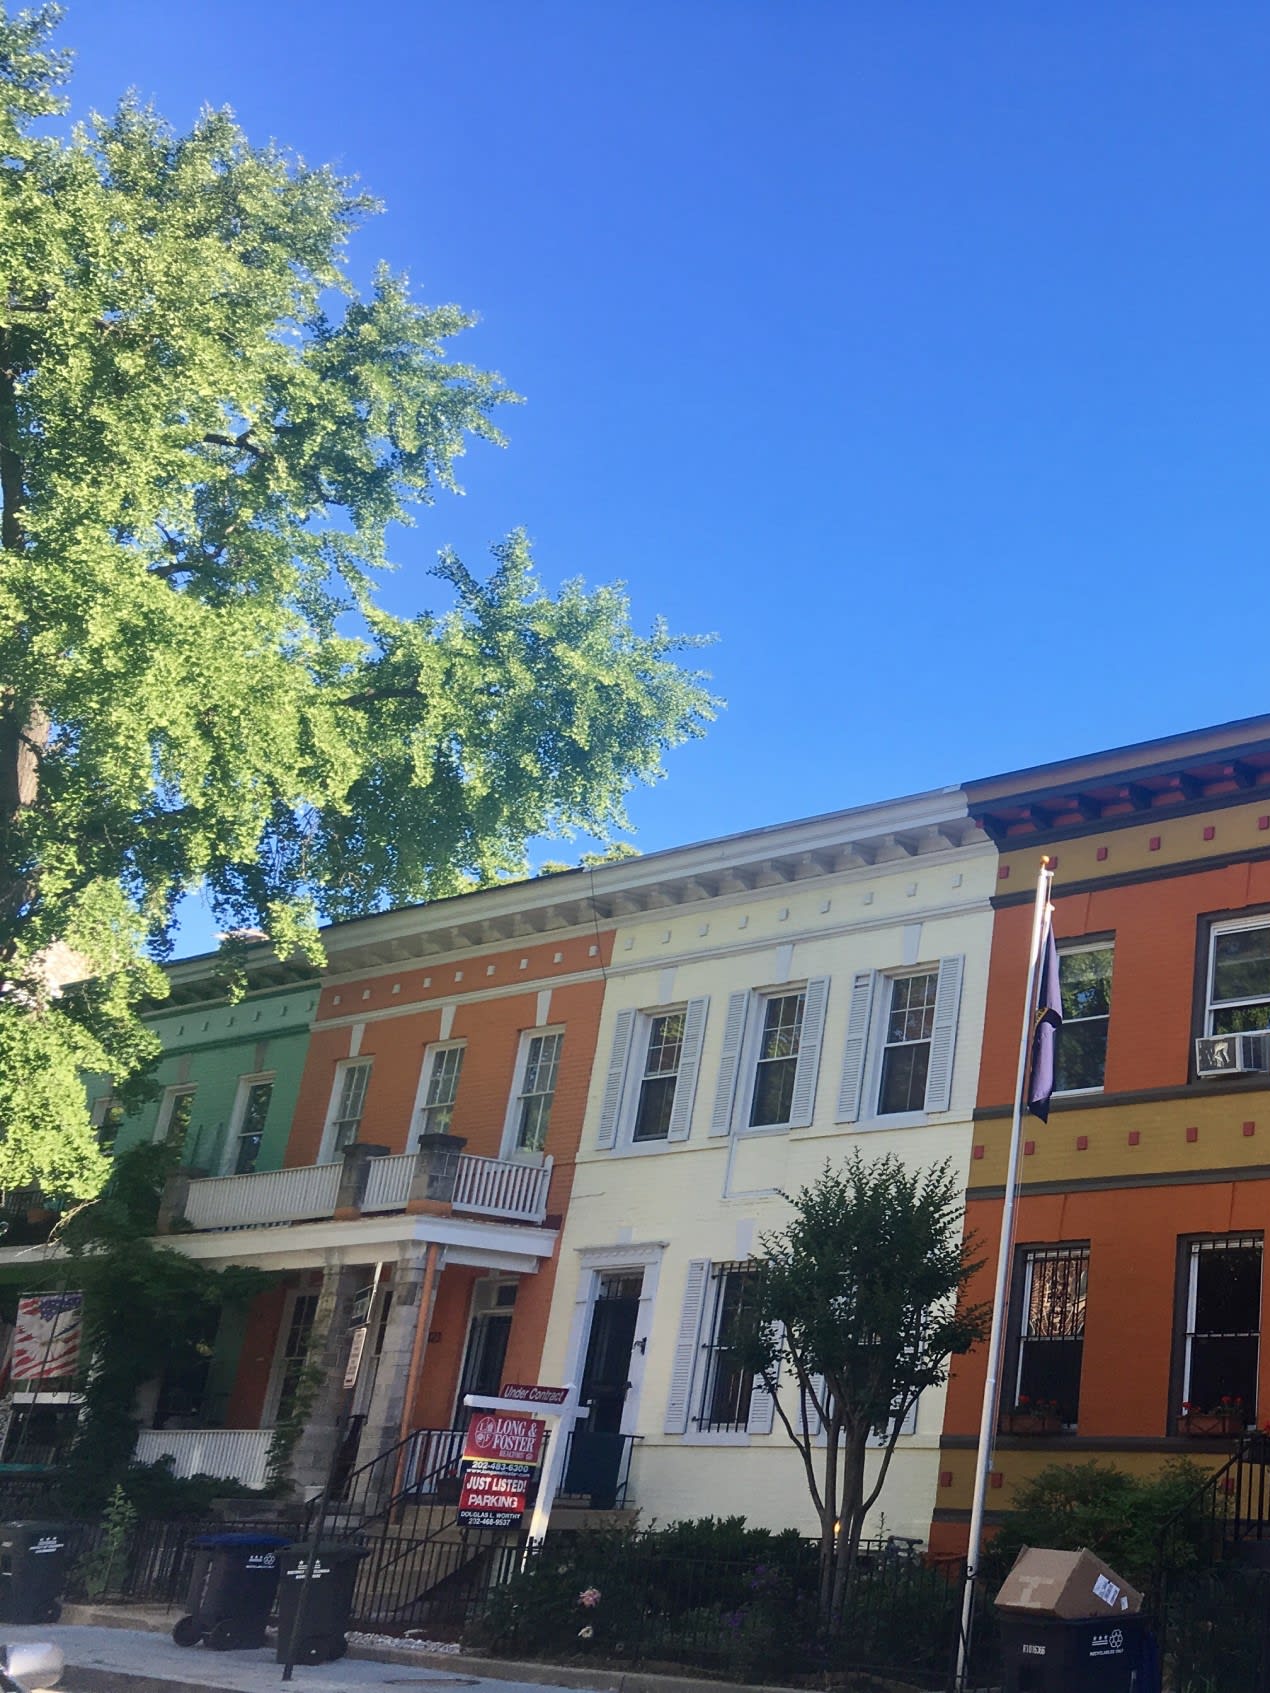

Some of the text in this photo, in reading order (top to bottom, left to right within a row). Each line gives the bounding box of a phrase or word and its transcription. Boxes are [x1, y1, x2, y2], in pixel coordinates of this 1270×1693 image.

[504, 1385, 564, 1402] Under Contract
[496, 1418, 537, 1438] LONG &
[492, 1433, 536, 1452] FOSTER
[471, 1460, 529, 1473] 202-483-6300
[466, 1475, 527, 1493] JUST LISTED!
[468, 1493, 518, 1508] PARKING
